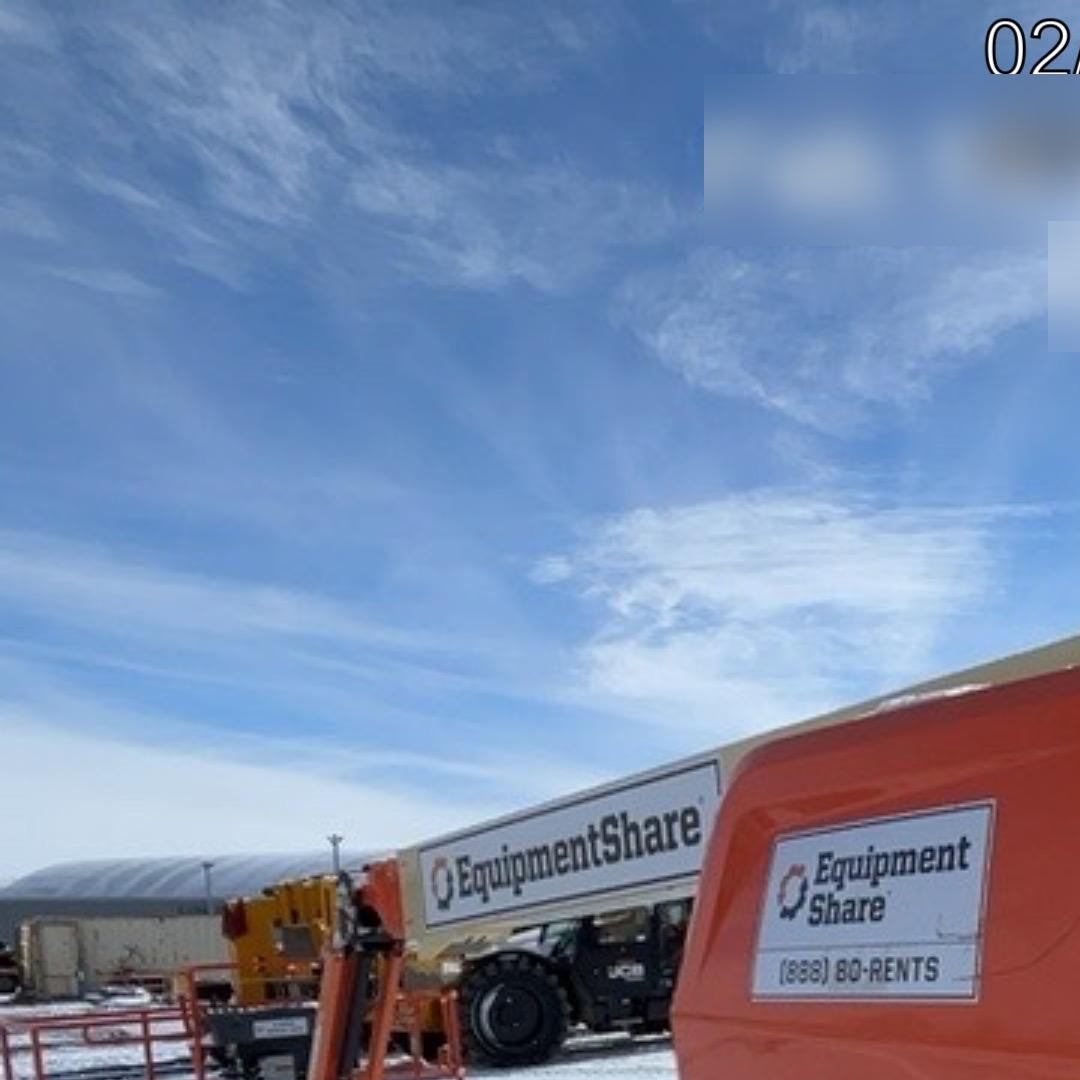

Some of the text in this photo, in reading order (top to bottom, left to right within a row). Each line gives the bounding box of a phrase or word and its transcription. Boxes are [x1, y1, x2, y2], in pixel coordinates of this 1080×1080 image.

[455, 805, 702, 903] EquipmentShare
[813, 836, 972, 891] Equipment
[807, 893, 887, 926] Share
[779, 956, 940, 986] (888) 80-RENTS
